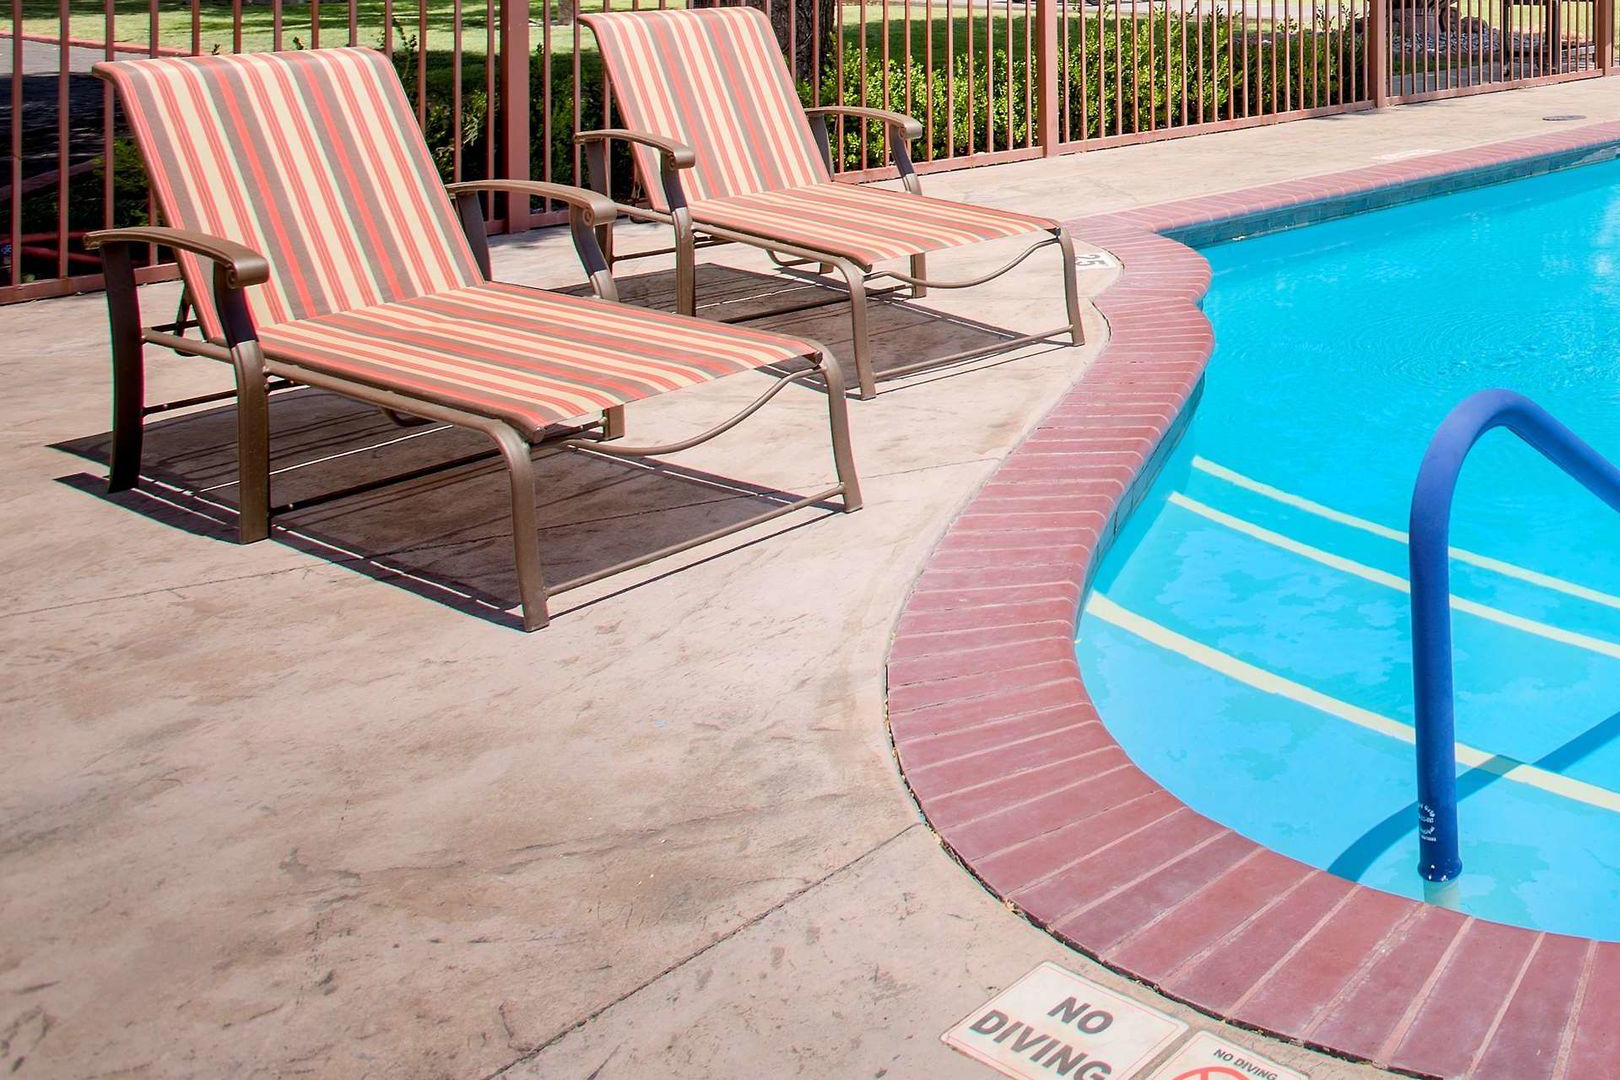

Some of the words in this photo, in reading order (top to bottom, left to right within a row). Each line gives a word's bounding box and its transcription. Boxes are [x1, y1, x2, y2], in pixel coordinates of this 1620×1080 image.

[1047, 996, 1114, 1034] NO
[969, 1009, 1112, 1080] DIVING
[1213, 1048, 1234, 1062] NO
[1234, 1057, 1279, 1080] DIVING
